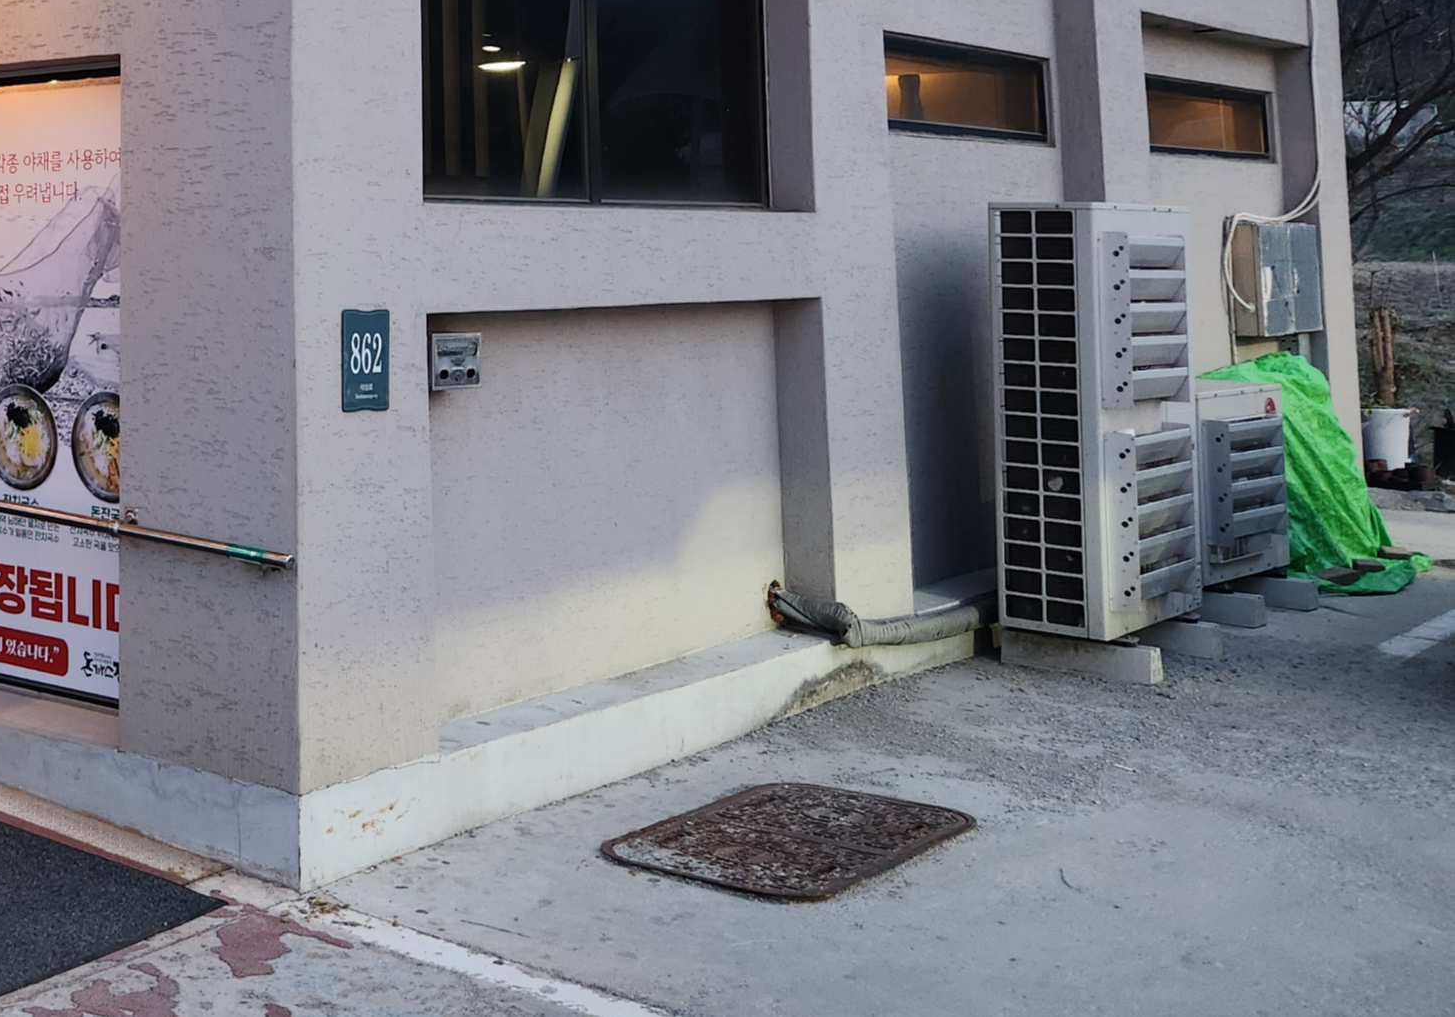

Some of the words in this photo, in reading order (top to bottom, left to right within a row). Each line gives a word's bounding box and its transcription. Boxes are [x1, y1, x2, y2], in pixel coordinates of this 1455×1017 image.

[23, 150, 63, 173] 야채를
[66, 146, 121, 171] 사용하여
[13, 181, 82, 204] 우려냅니다.
[350, 333, 382, 374] 862
